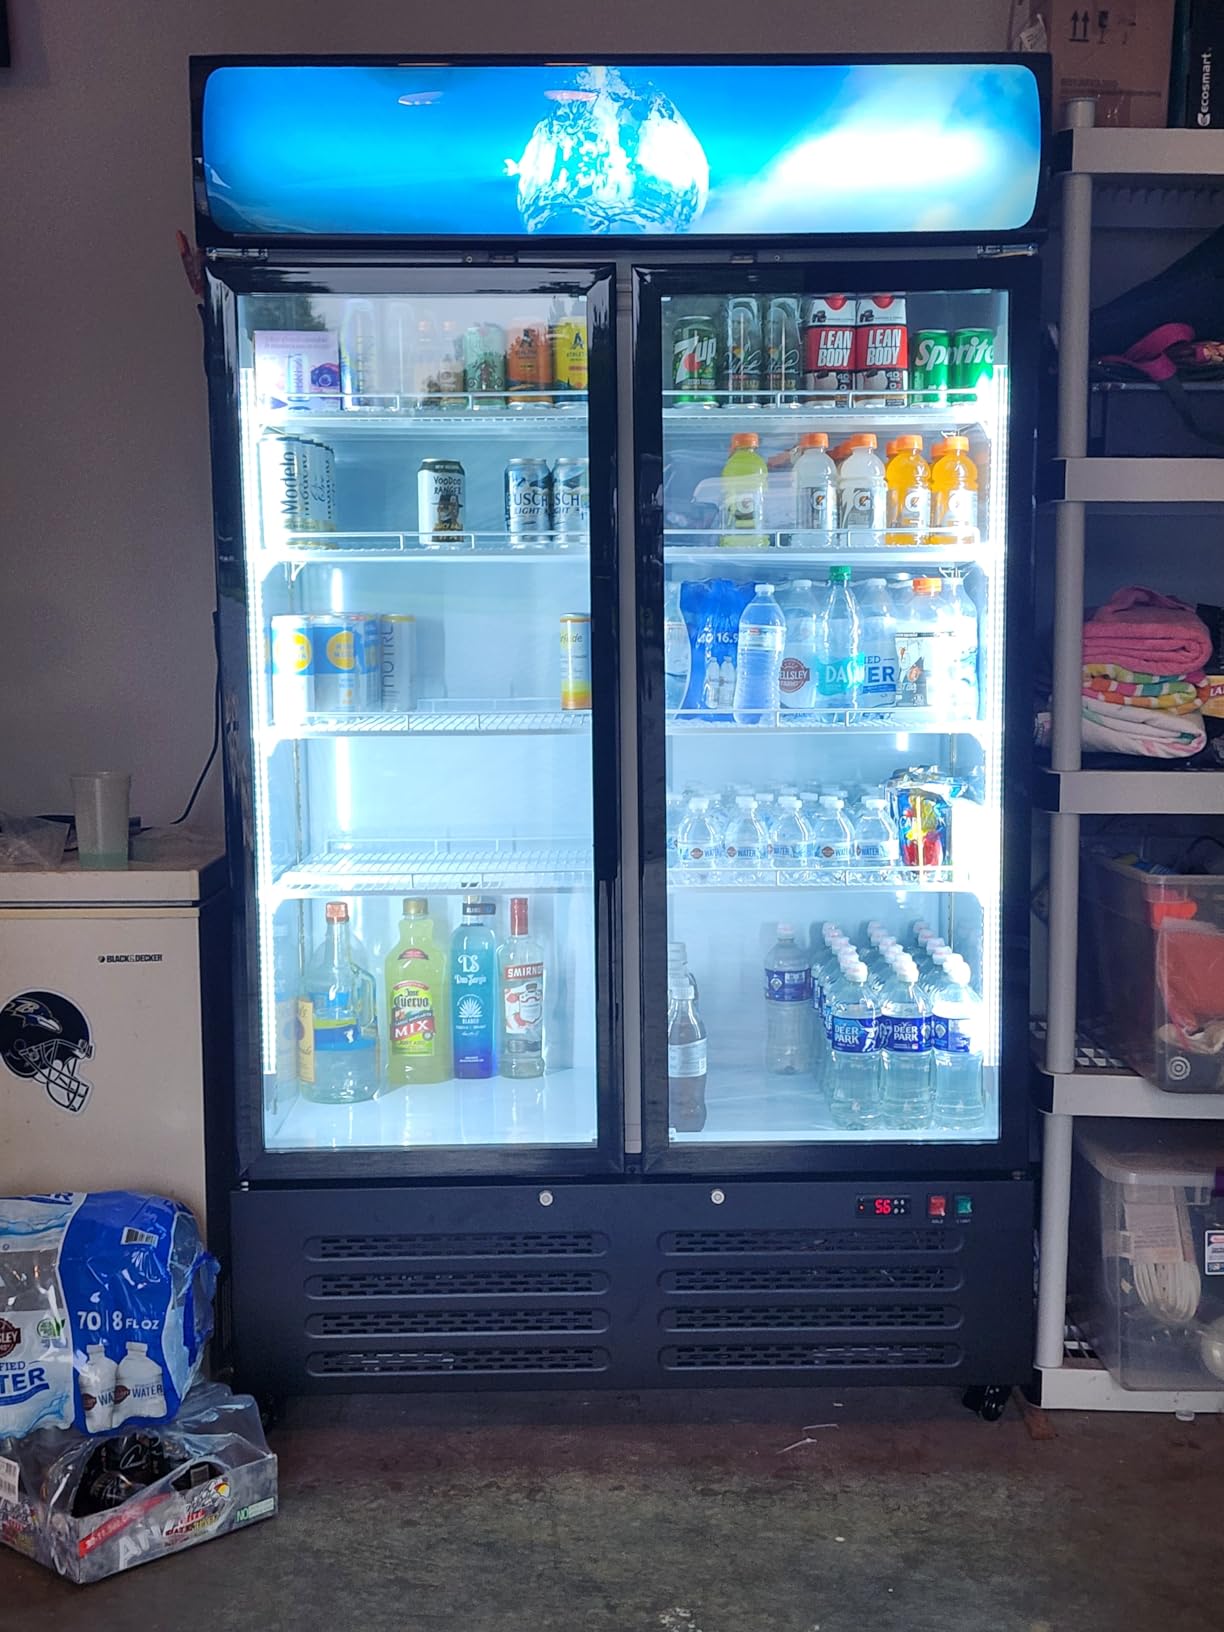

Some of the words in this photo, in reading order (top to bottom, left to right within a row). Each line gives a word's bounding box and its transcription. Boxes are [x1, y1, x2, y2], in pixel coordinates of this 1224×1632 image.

[1200, 52, 1211, 113] ecosmart
[820, 330, 853, 349] LEAN
[868, 329, 901, 348] LEAN
[817, 349, 850, 367] BODY
[866, 347, 899, 366] BODY
[280, 452, 298, 515] Modelo
[513, 493, 548, 506] USCH
[554, 493, 579, 506] SCH
[780, 670, 807, 680] ELLSLEY
[394, 1020, 429, 1038] MIX
[834, 1025, 859, 1035] DEER
[893, 1024, 918, 1034] DEER
[893, 1032, 918, 1042] PARK
[834, 1034, 860, 1044] PARK
[77, 1311, 102, 1331] 70
[112, 1310, 123, 1331] 8
[125, 1318, 140, 1329] FL
[141, 1319, 160, 1330] OZ
[0, 1361, 26, 1371] FIED
[0, 1367, 46, 1394] TER
[132, 1384, 164, 1398] WATER
